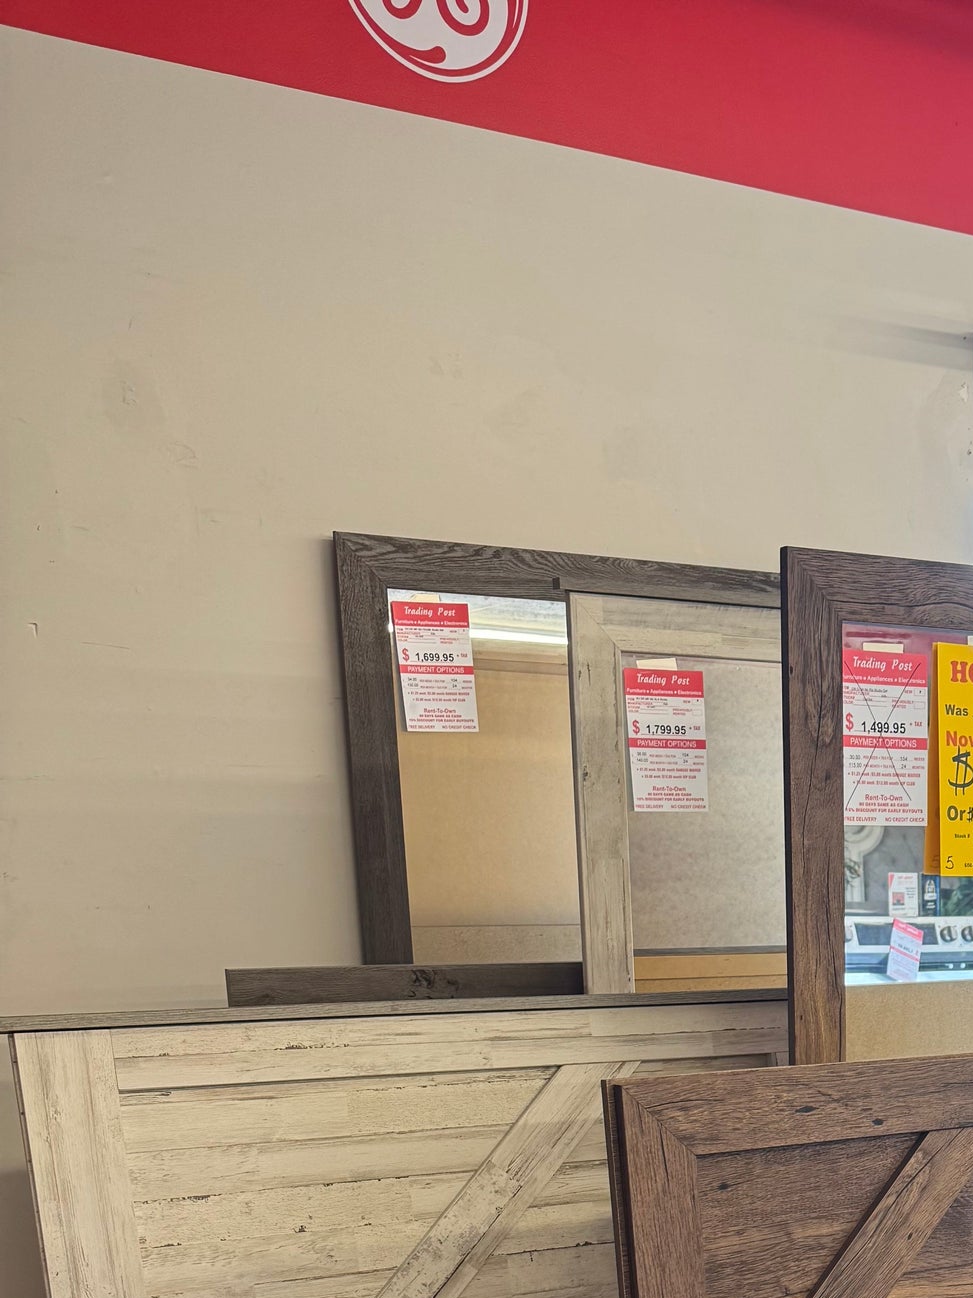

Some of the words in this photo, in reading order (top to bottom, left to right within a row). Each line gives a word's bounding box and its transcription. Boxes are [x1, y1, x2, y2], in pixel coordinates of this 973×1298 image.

[404, 606, 433, 617] Trading
[438, 608, 456, 617] Post
[402, 648, 410, 662] $
[416, 652, 454, 662] 1,699.95
[853, 656, 886, 672] Trading
[892, 659, 913, 671] Post
[637, 673, 666, 686] Trading
[671, 675, 690, 685] Post
[945, 704, 969, 716] Was
[632, 719, 640, 735] $
[646, 724, 686, 735] 1,799.95
[846, 712, 854, 732] $
[862, 721, 906, 734] 1,499.95
[850, 737, 883, 746] PAYMENT
[885, 739, 917, 748] OPTIONS
